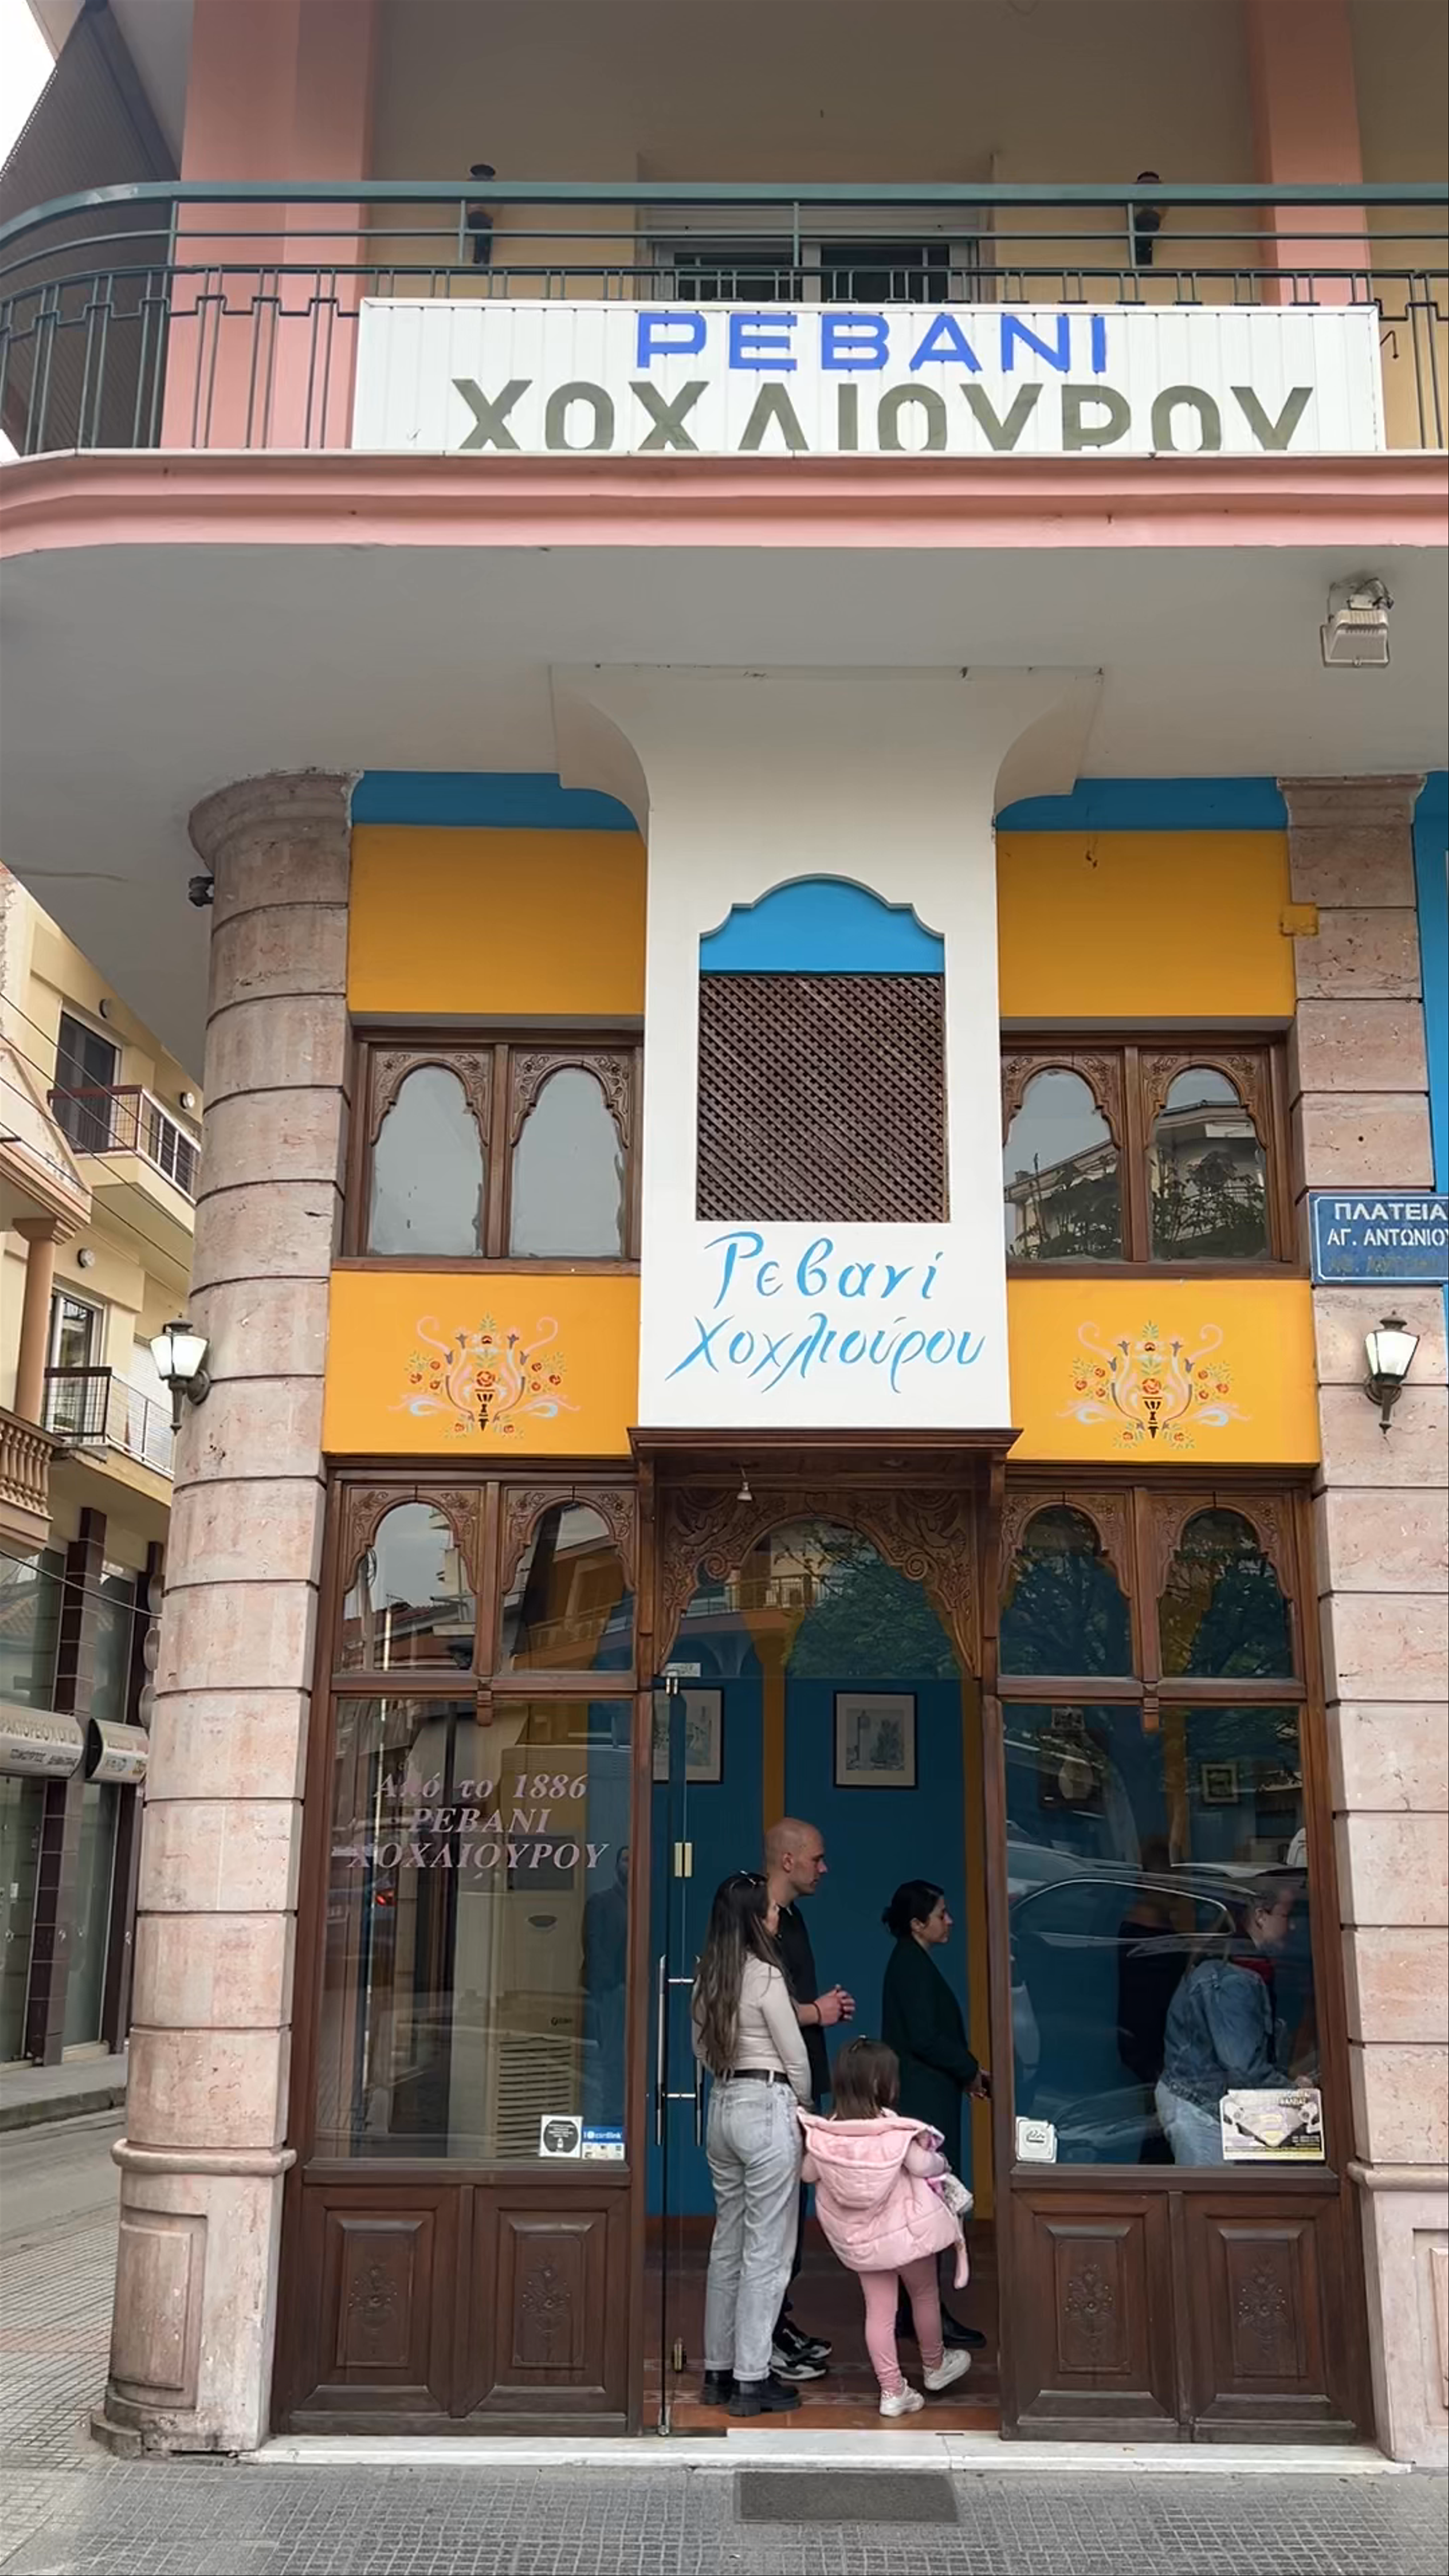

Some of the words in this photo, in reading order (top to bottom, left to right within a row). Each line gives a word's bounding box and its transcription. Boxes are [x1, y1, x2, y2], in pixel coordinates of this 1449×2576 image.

[637, 312, 1106, 373] ΡΕΒΑΝΙ
[1334, 1203, 1448, 1220] ΠΛΑΤΕΙΑ
[1327, 1229, 1357, 1246] ΑΓ.
[704, 1231, 943, 1309] Ρεβανί
[665, 1313, 985, 1393] Χοχλιούρου
[459, 1779, 493, 1798] το
[513, 1774, 588, 1798] 1886
[408, 1809, 552, 1833] ΡΕΒΑΝΙ
[346, 1844, 611, 1869] ΧΟΧΛΙΟΥΡΟΥ
